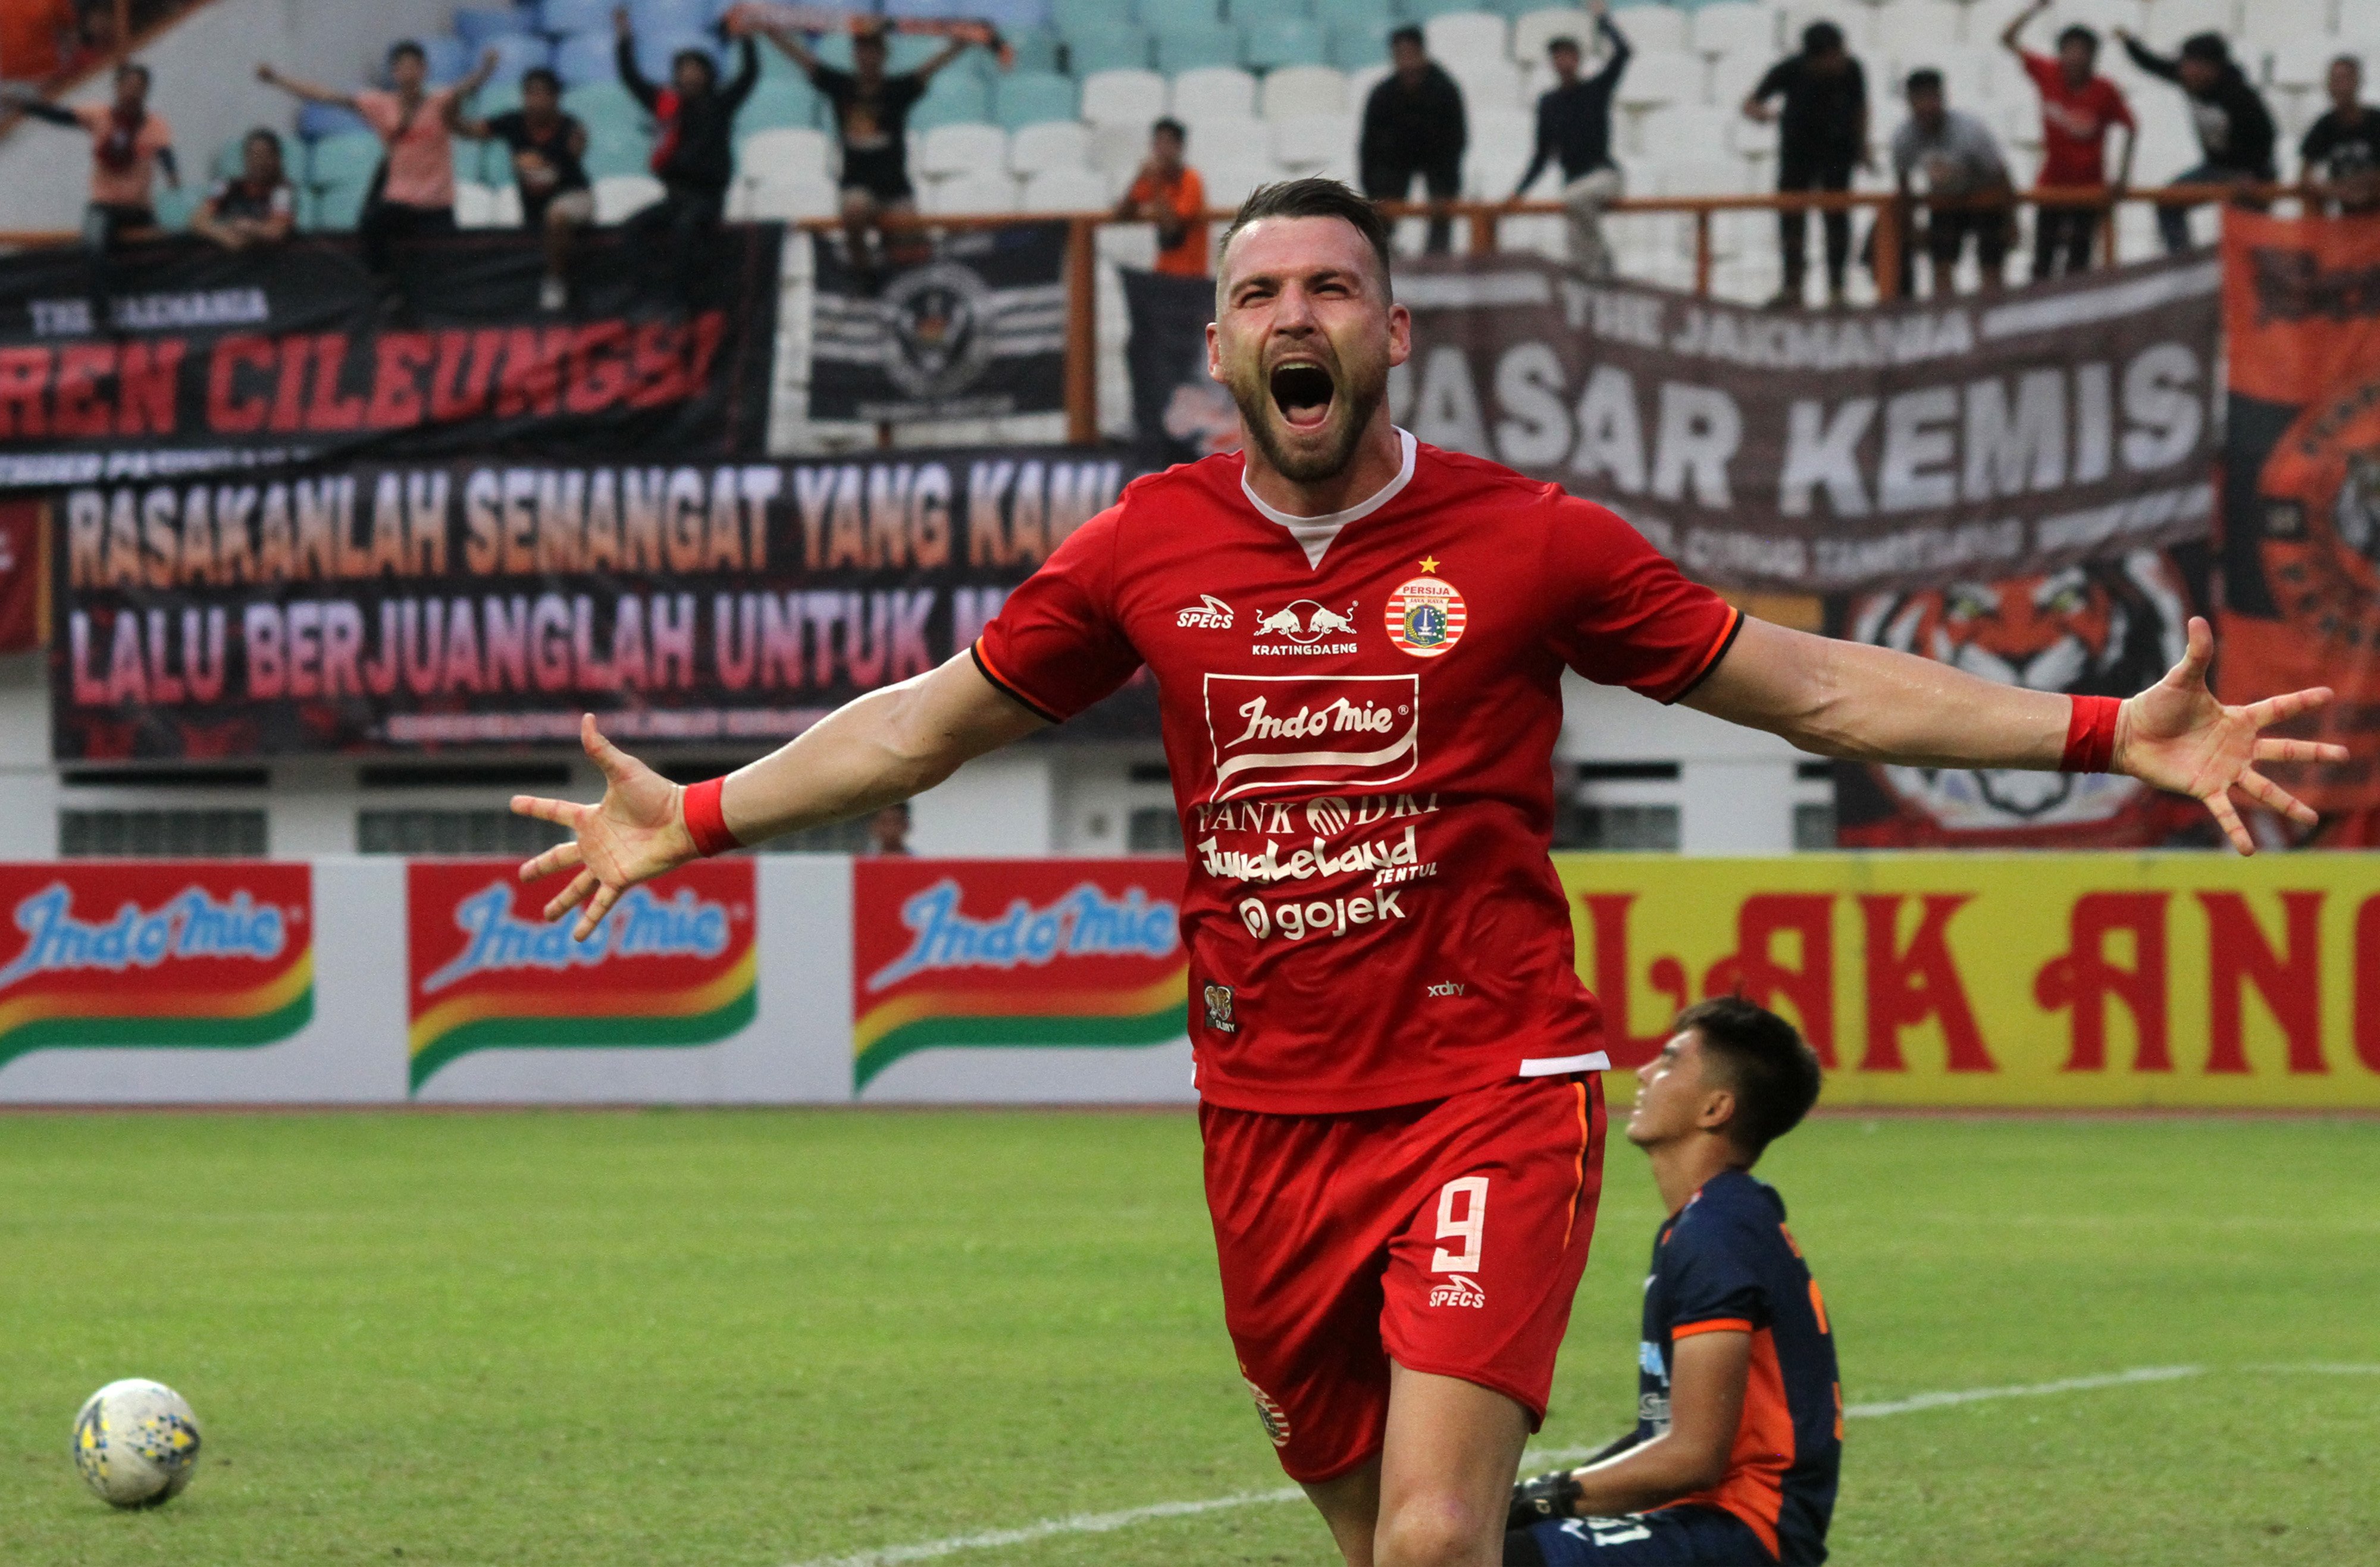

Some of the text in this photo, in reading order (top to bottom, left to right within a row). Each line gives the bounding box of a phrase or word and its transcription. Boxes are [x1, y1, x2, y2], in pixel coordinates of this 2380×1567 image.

[1561, 277, 1663, 347] THE
[1779, 342, 2203, 518] KEMIS
[67, 471, 450, 589] RASAKANLAH
[465, 464, 781, 576] SEMANGAT
[794, 462, 952, 573] YANG
[1402, 586, 1450, 596] PERSIJA
[1176, 612, 1234, 629] SPECS
[70, 606, 227, 707] LALU
[244, 594, 697, 700] BERJUANGLAH
[716, 589, 937, 691] UNTUK
[1252, 643, 1358, 656] KRATINGDAENG
[1373, 861, 1438, 887] SENTUL
[1275, 889, 1406, 940] gojek
[1432, 1176, 1489, 1273] 9
[1429, 1290, 1485, 1308] SPECS
